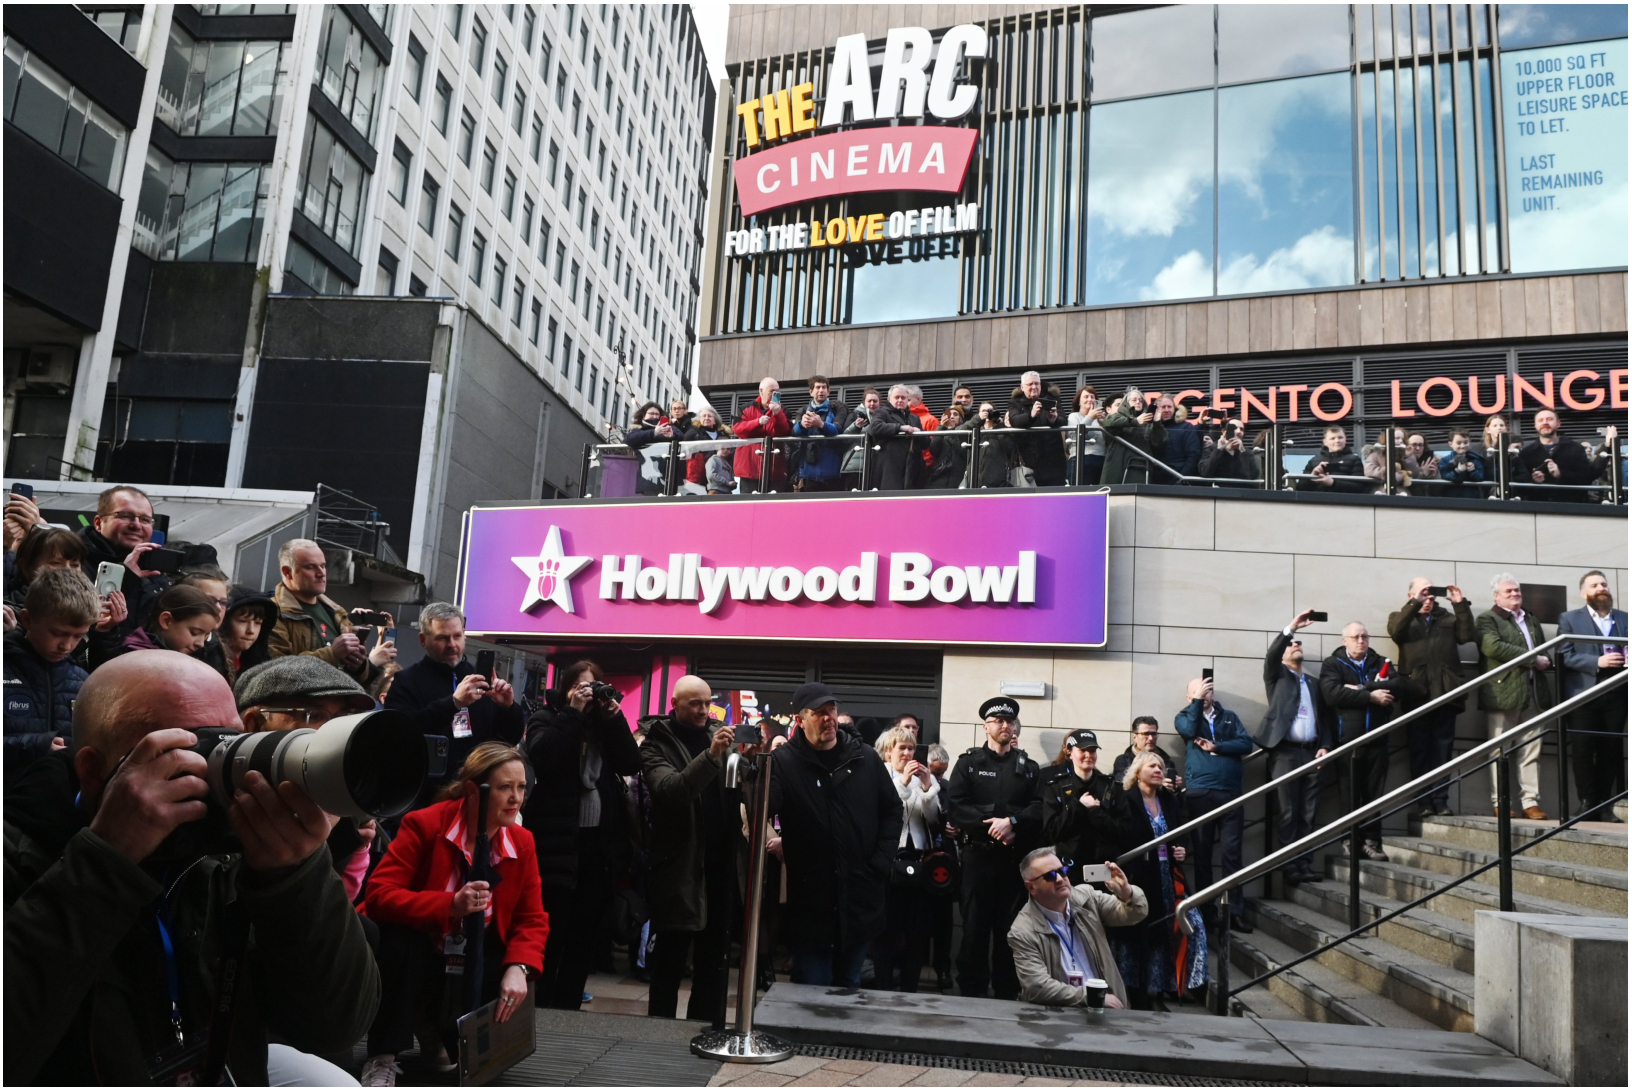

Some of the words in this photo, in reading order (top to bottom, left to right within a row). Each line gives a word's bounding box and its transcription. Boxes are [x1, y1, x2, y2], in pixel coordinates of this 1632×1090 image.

[1516, 58, 1562, 76] 10,000
[1567, 55, 1586, 70] SQ
[1590, 52, 1606, 68] FT
[736, 81, 817, 149] THE
[821, 24, 988, 127] ARC
[1517, 77, 1563, 96] UPPER
[1568, 72, 1615, 91] FLOOR
[1518, 96, 1577, 116] LEISURE
[1582, 91, 1628, 110] SPACE
[1517, 121, 1535, 136] TO
[1540, 118, 1569, 134] LET.
[756, 141, 946, 194] CINEMA
[1520, 154, 1555, 171] LAST
[1521, 170, 1603, 192] REMAINING
[1523, 195, 1560, 213] UNIT.
[724, 228, 765, 257] FOR
[767, 222, 808, 251] THE
[810, 213, 886, 248] LOVE
[888, 209, 920, 239] OF
[920, 202, 979, 236] FILM
[1391, 368, 1628, 418] LOUNGE
[599, 551, 879, 614] Hollywood
[889, 550, 1037, 604] Bowl
[222, 959, 237, 992] EOS
[219, 995, 232, 1012] R6
